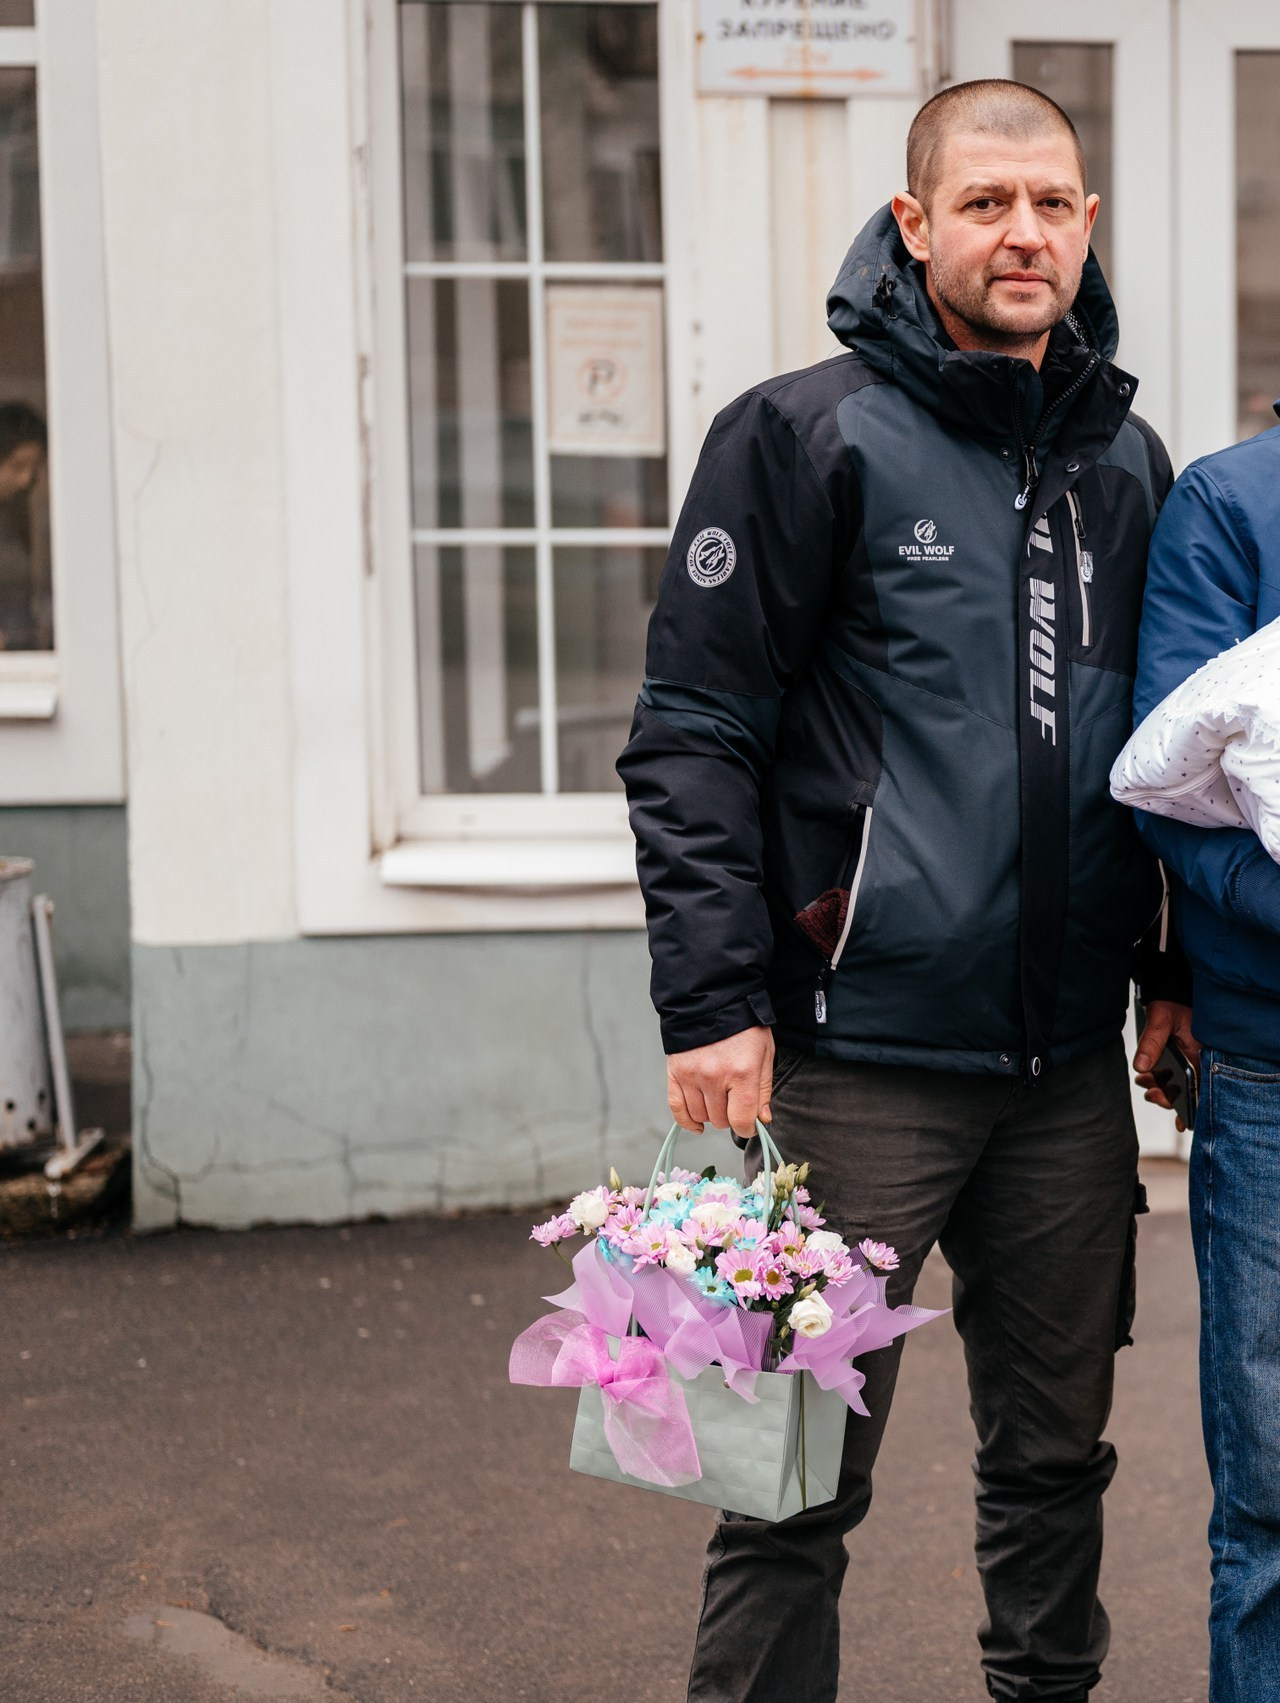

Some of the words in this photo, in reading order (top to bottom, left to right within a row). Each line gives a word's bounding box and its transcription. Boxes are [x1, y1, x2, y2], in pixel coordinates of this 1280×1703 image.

[718, 18, 896, 40] ЗАПРЕЩЕНО
[898, 545, 922, 555] EVIL
[923, 545, 955, 555] WOLF
[1029, 577, 1056, 746] WOLF
